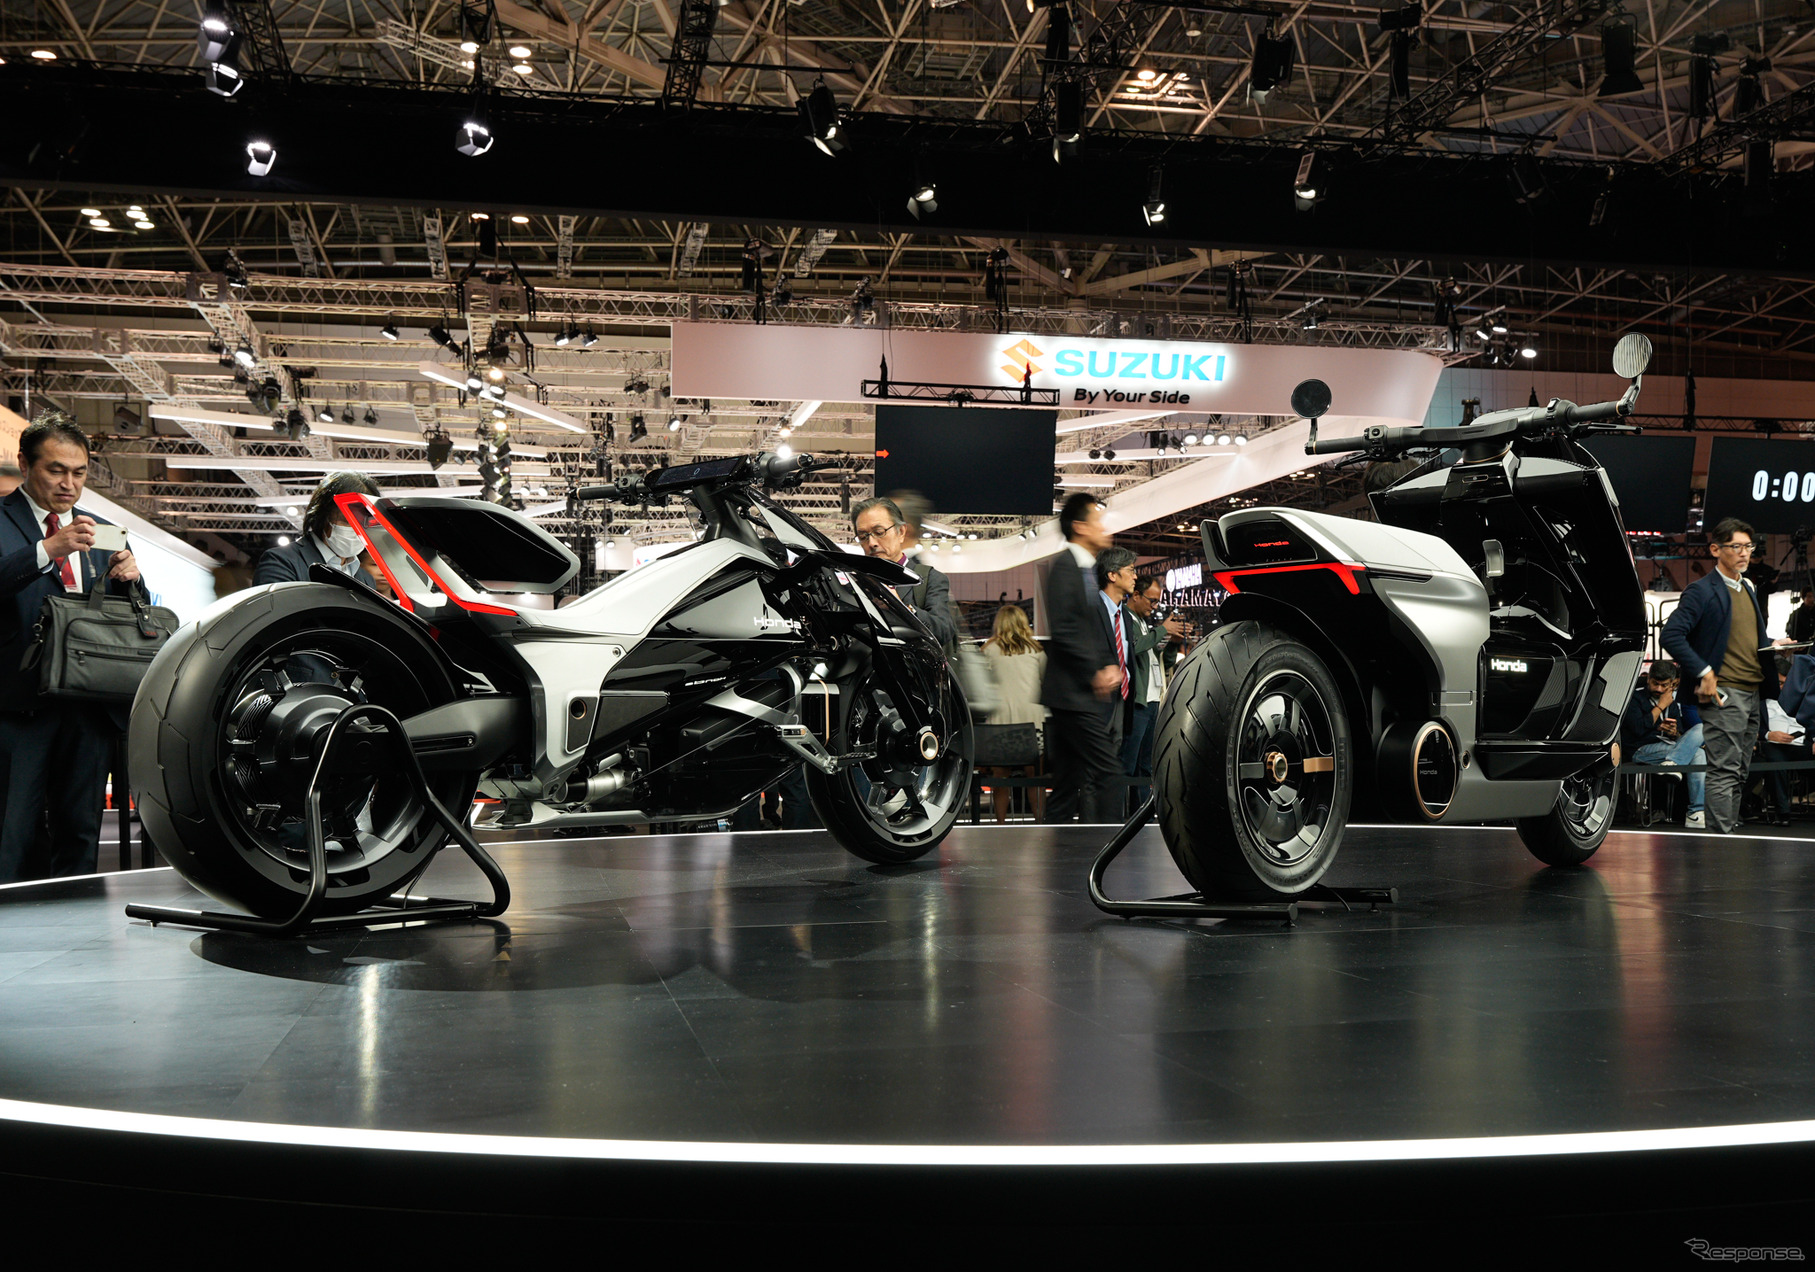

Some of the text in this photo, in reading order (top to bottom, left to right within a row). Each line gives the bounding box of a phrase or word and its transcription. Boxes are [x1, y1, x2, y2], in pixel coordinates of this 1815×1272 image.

[1054, 349, 1226, 382] SUZUKI
[1074, 388, 1190, 404] By Your Side
[1752, 469, 1815, 503] 0:00
[753, 616, 802, 629] Honda
[1491, 658, 1527, 672] Honda
